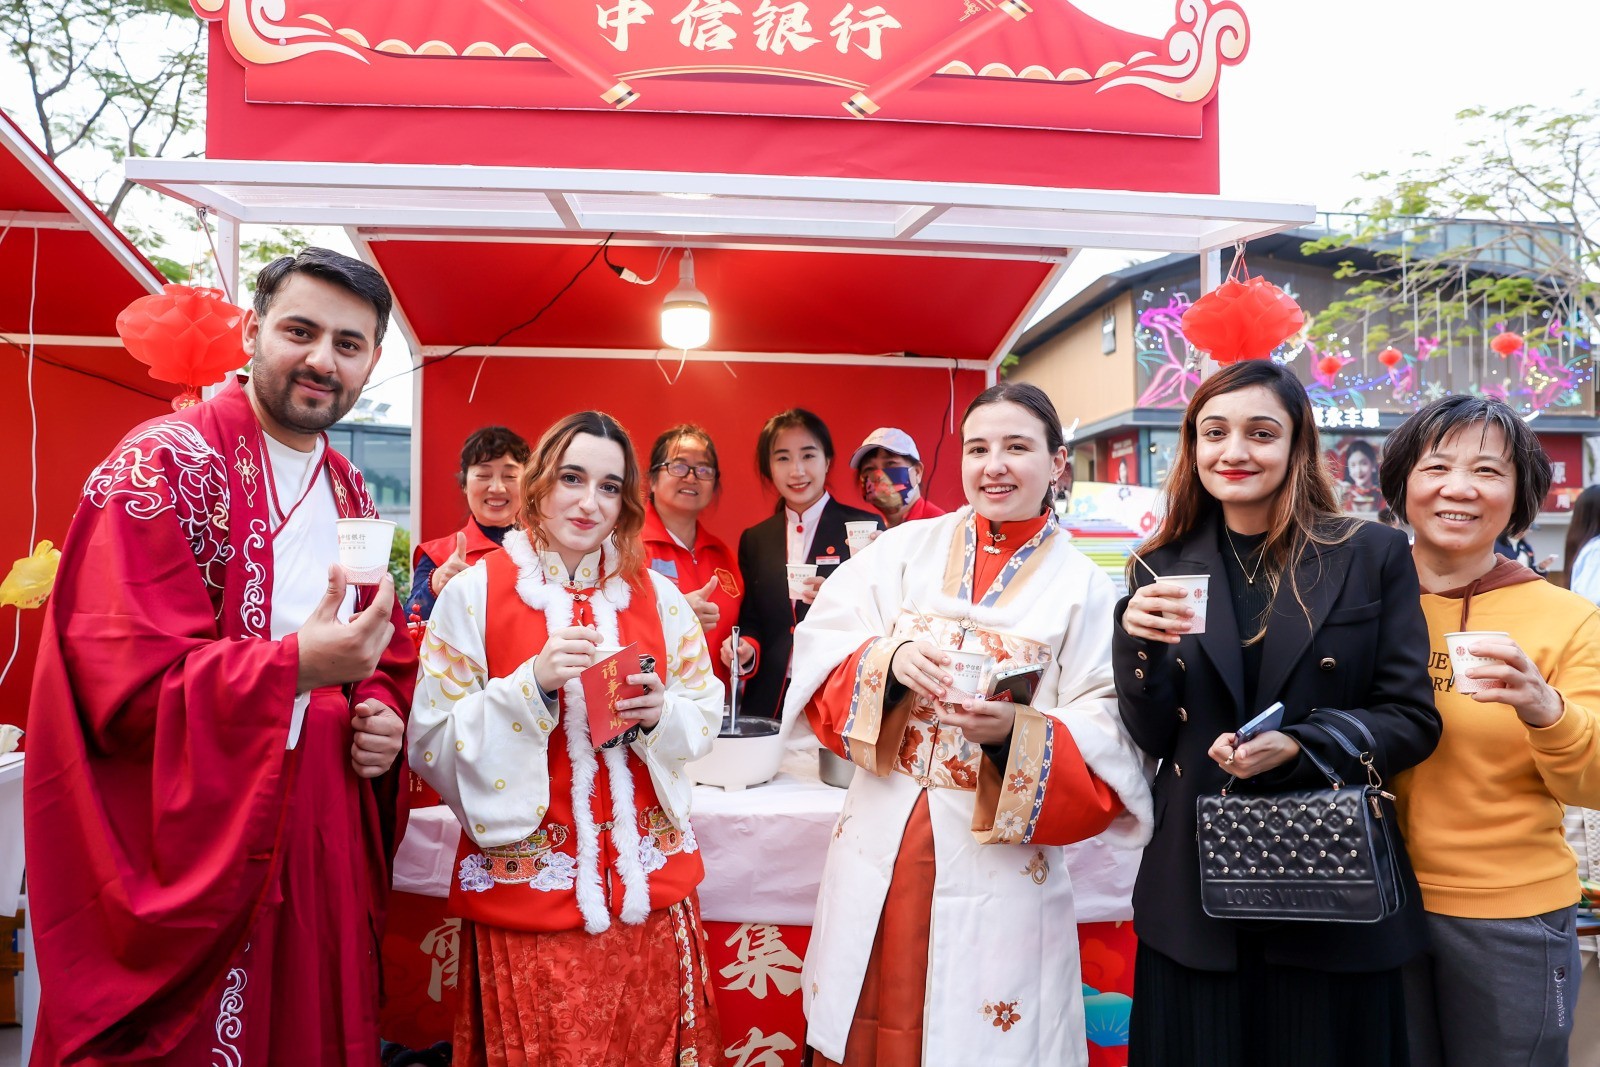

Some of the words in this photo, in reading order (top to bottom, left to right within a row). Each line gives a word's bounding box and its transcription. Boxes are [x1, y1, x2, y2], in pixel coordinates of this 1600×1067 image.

[597, 0, 903, 60] 中信银行
[1224, 888, 1272, 905] LOUIS
[719, 924, 804, 1000] 集
